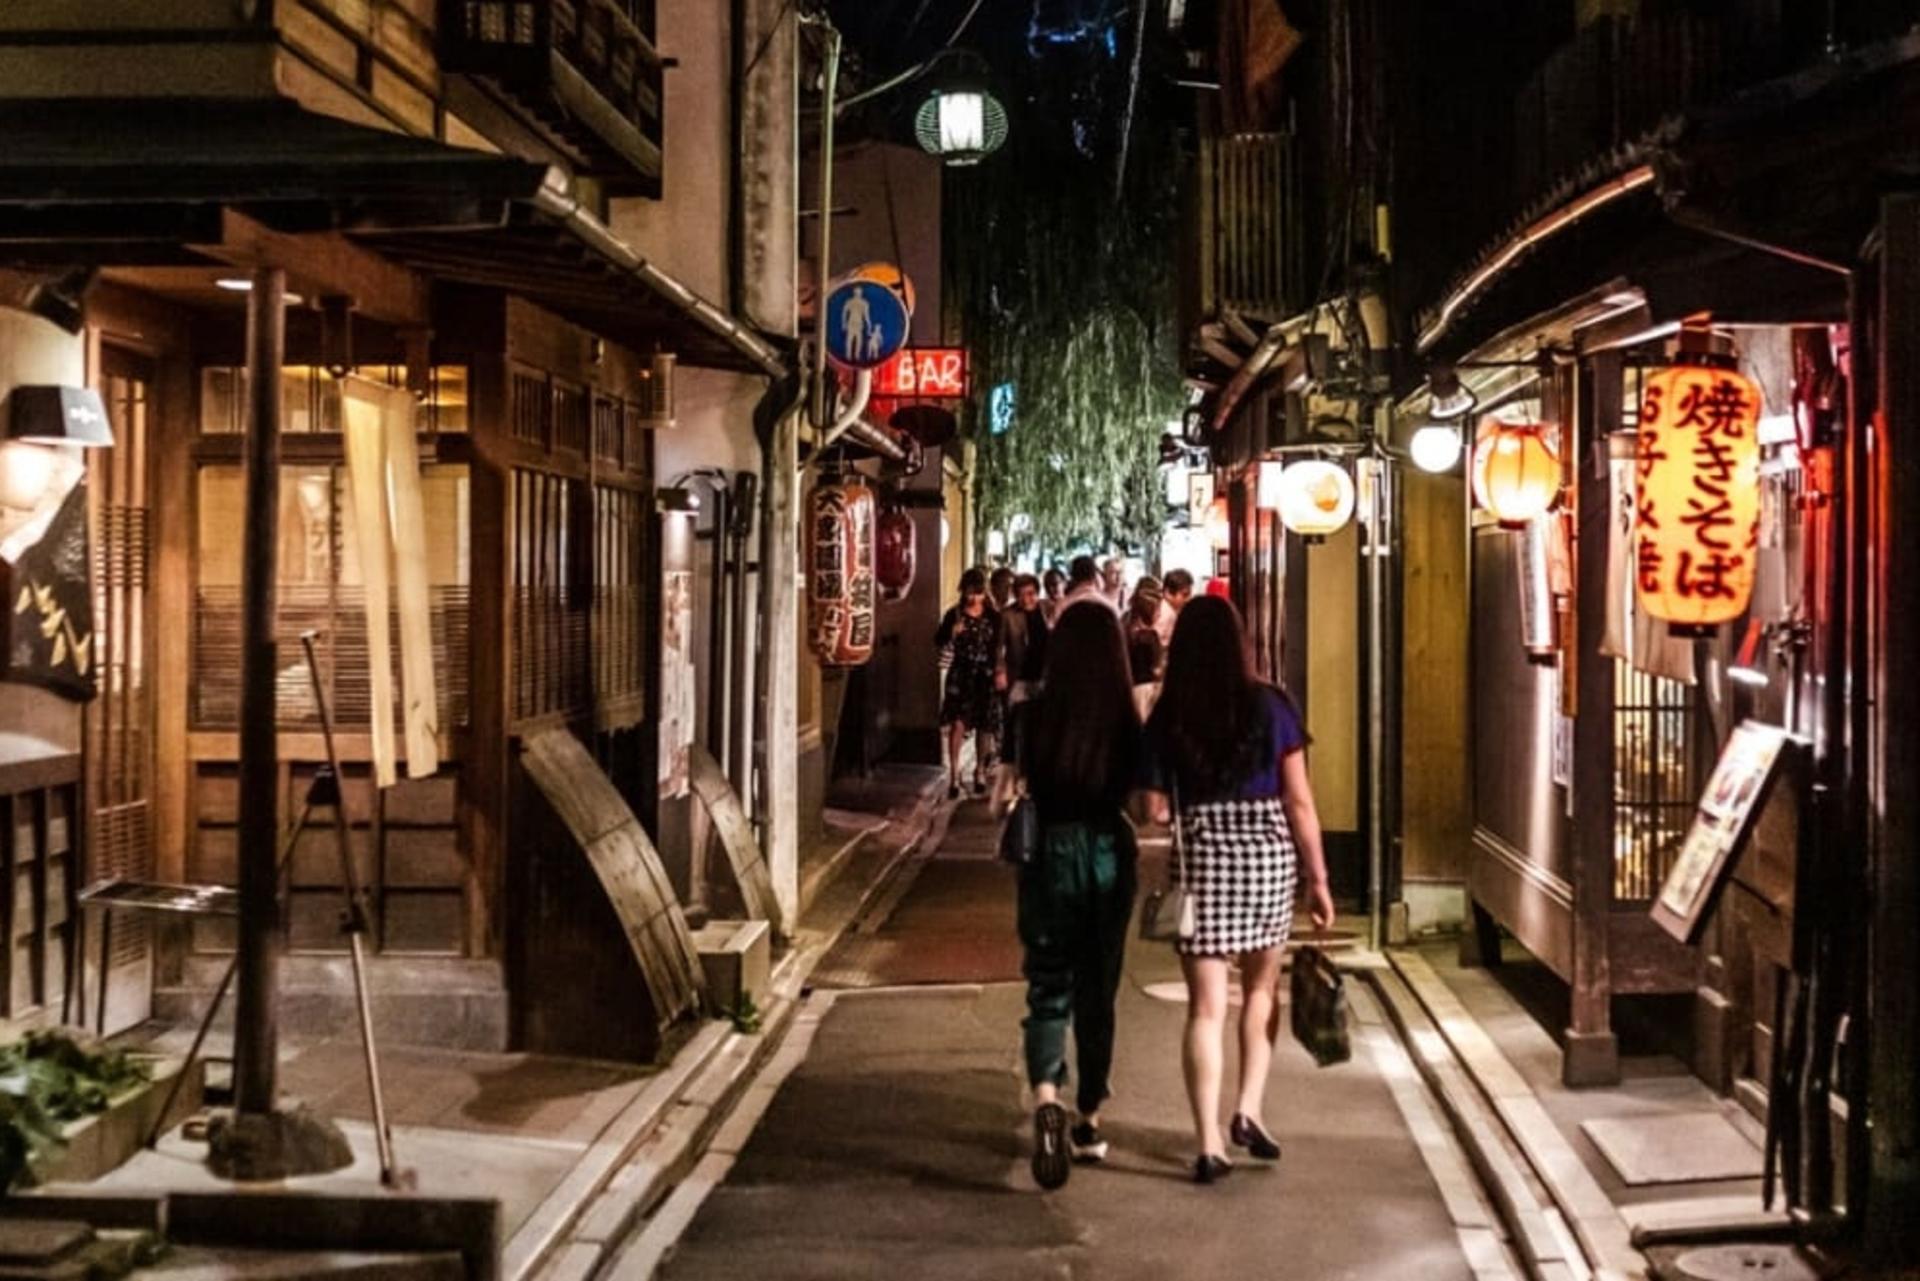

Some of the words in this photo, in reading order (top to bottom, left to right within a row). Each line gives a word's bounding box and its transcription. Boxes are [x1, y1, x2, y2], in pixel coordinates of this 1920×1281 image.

[898, 354, 963, 391] BAR
[1674, 379, 1750, 600] 焼きそば
